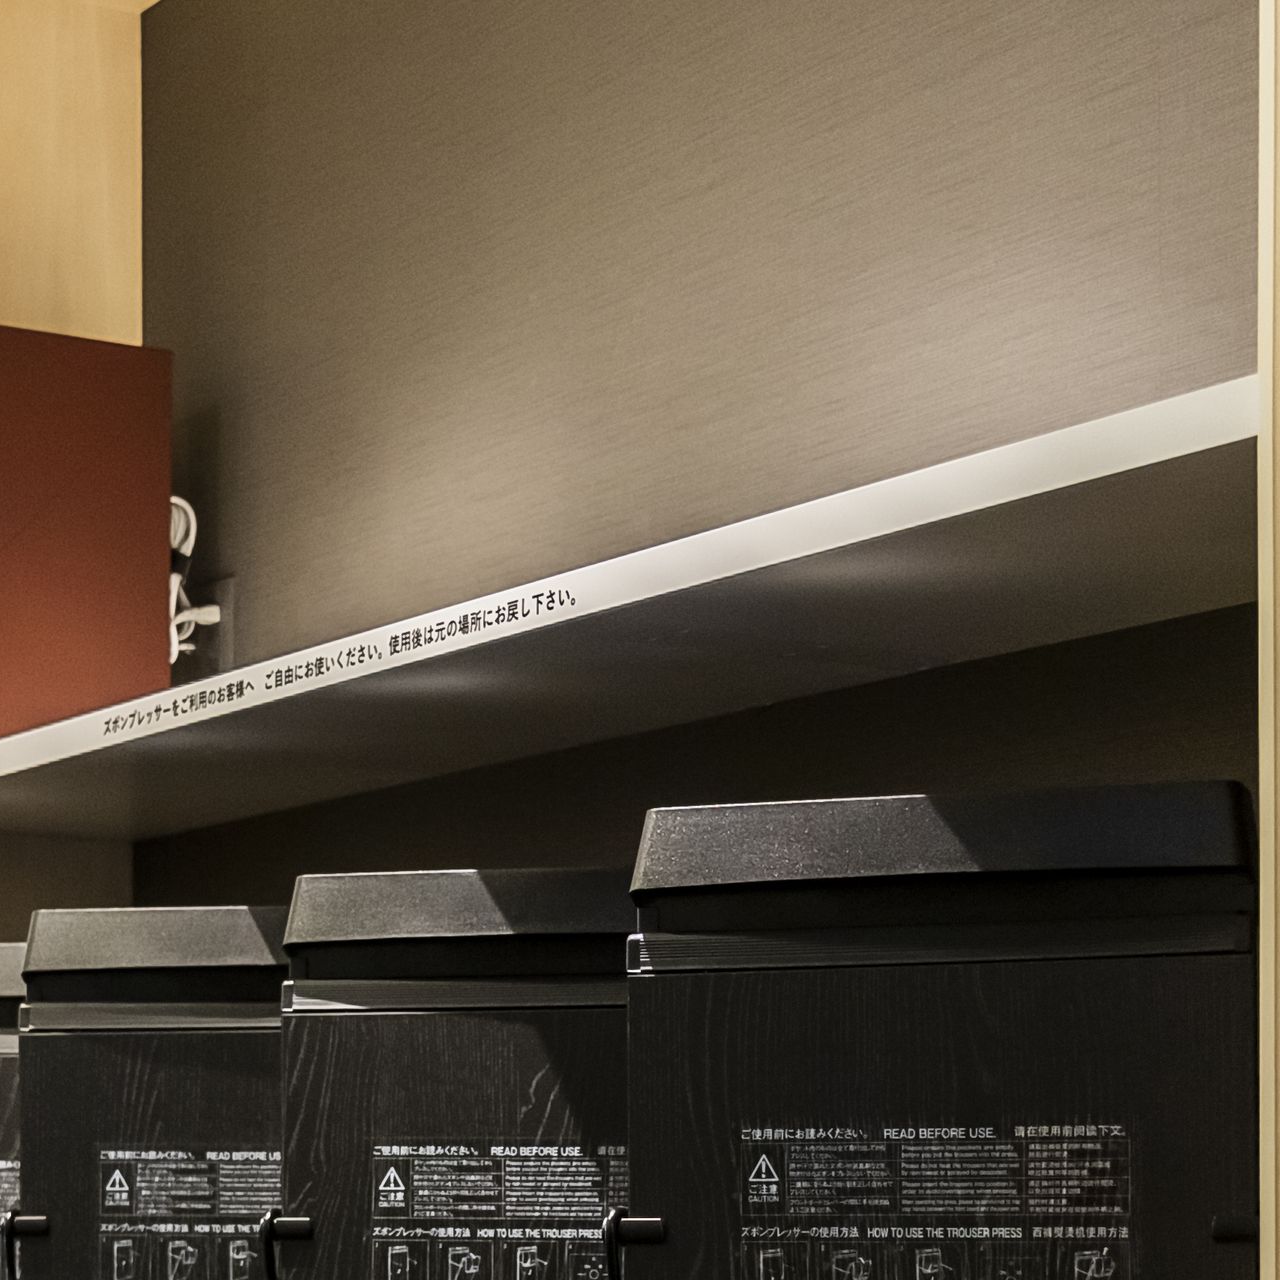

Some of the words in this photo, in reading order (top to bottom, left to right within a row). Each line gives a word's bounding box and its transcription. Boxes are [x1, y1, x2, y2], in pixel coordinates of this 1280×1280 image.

[883, 1128, 916, 1139] READ
[919, 1127, 966, 1139] BEFORE
[969, 1127, 997, 1139] USE.
[206, 1151, 230, 1161] READ
[232, 1151, 266, 1161] BEFORE
[490, 1146, 517, 1157] READ
[520, 1146, 559, 1157] BEFORE
[560, 1146, 583, 1157] USE.
[748, 1195, 780, 1203] CAUTION
[477, 1228, 495, 1240] HOW
[496, 1228, 507, 1240] TO
[508, 1228, 524, 1240] USE
[525, 1228, 540, 1240] THE
[542, 1228, 577, 1240] TROUSER
[867, 1227, 888, 1239] HOW
[891, 1227, 904, 1239] TO
[905, 1227, 924, 1239] USE
[926, 1227, 945, 1239] THE
[946, 1227, 990, 1239] TROUSER
[992, 1227, 1023, 1239] PRESS
